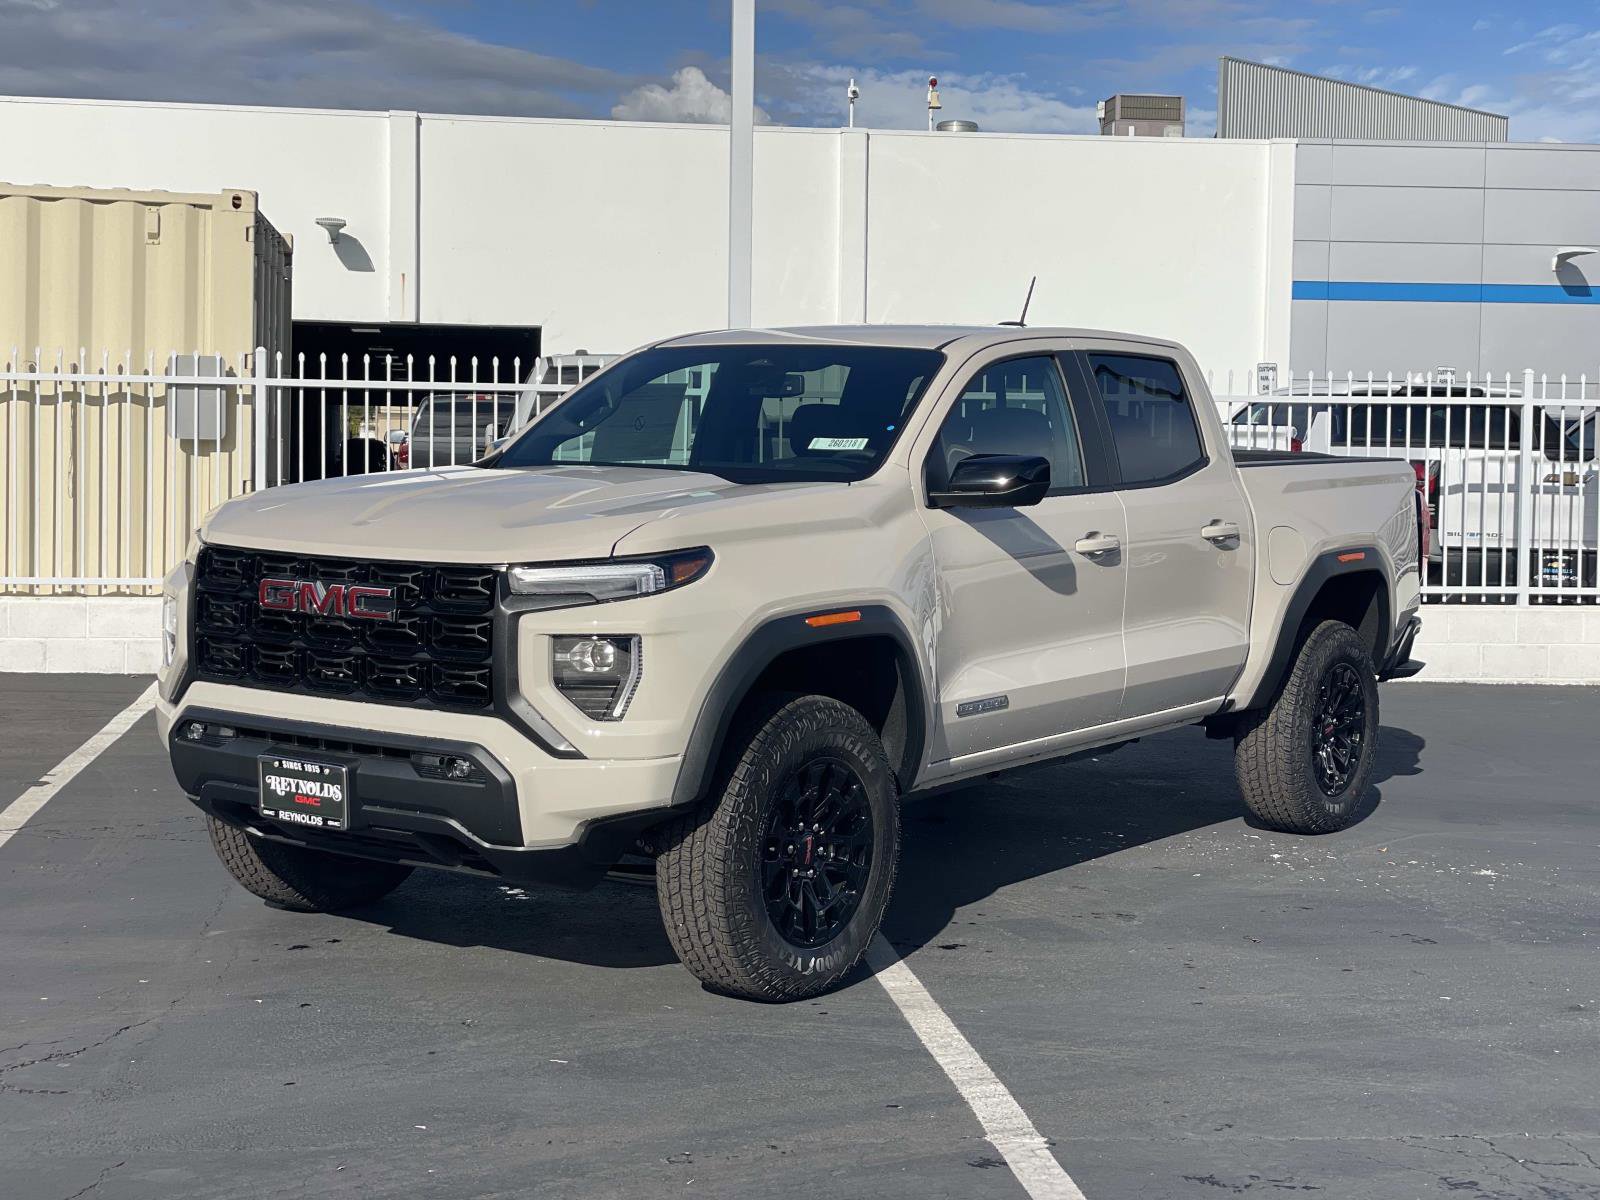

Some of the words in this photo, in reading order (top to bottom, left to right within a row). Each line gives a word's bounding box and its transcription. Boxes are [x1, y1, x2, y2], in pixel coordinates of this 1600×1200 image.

[259, 578, 396, 620] GMC
[281, 760, 303, 771] SINCE
[303, 763, 321, 774] 1915
[265, 775, 342, 802] REYNOLDS
[295, 794, 321, 806] GMC
[278, 810, 323, 826] REYNOLDS
[775, 945, 847, 976] OODYEA
